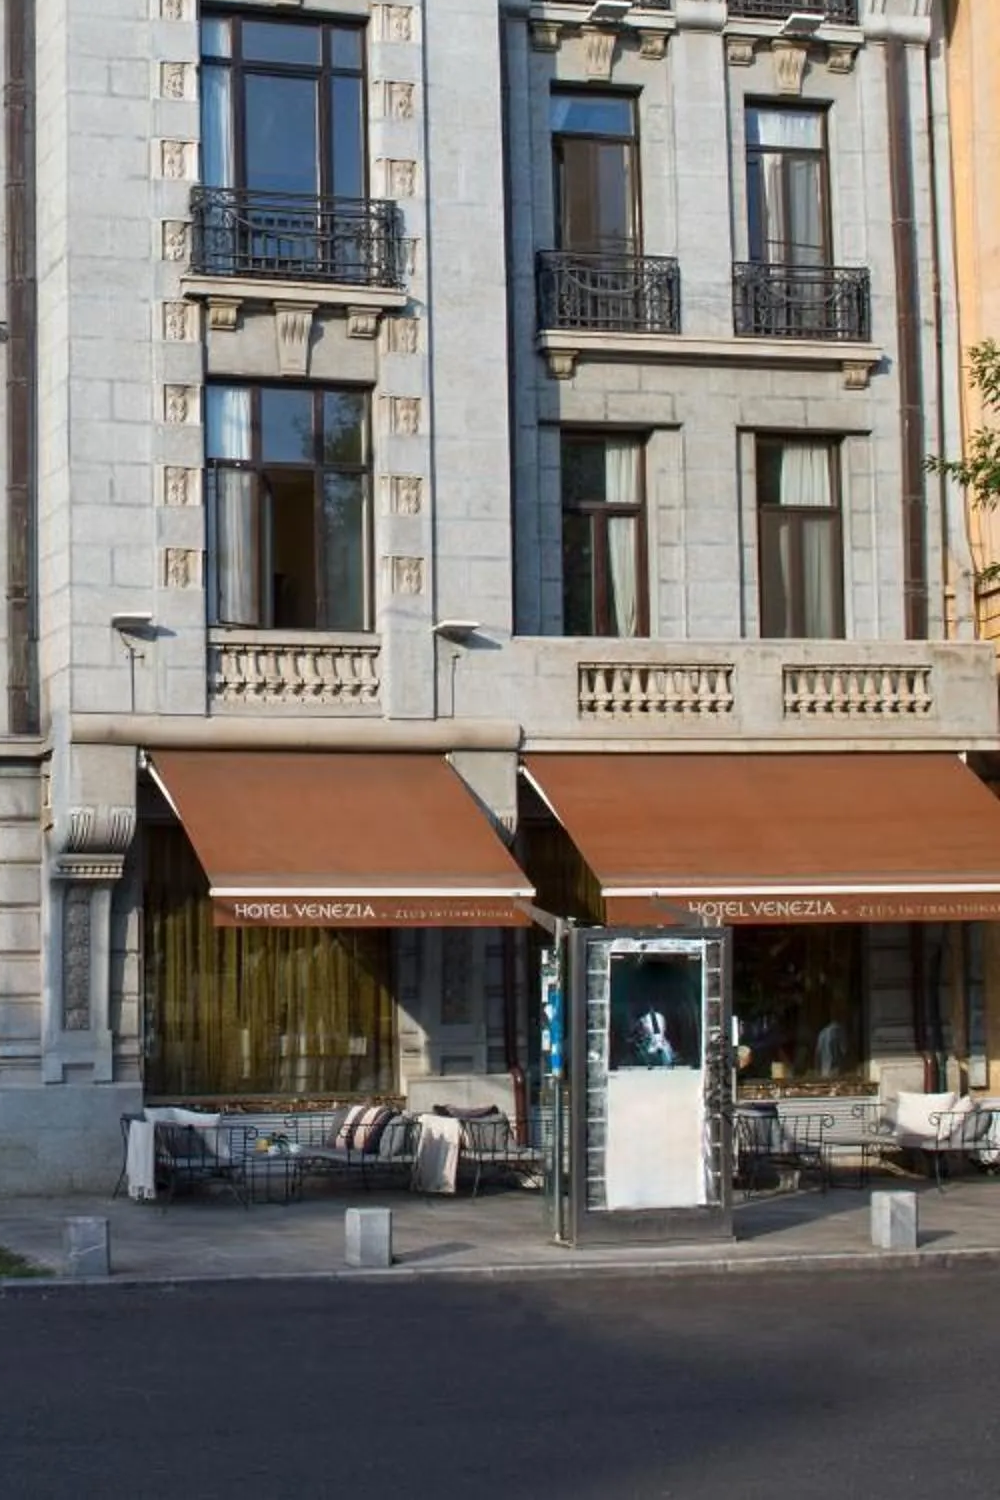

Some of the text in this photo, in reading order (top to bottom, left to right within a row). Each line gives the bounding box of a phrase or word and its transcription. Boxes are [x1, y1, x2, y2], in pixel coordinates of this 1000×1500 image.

[235, 902, 375, 919] HOTEL VENEZIA
[689, 901, 749, 917] HOTEL
[751, 900, 836, 917] VENEZIA
